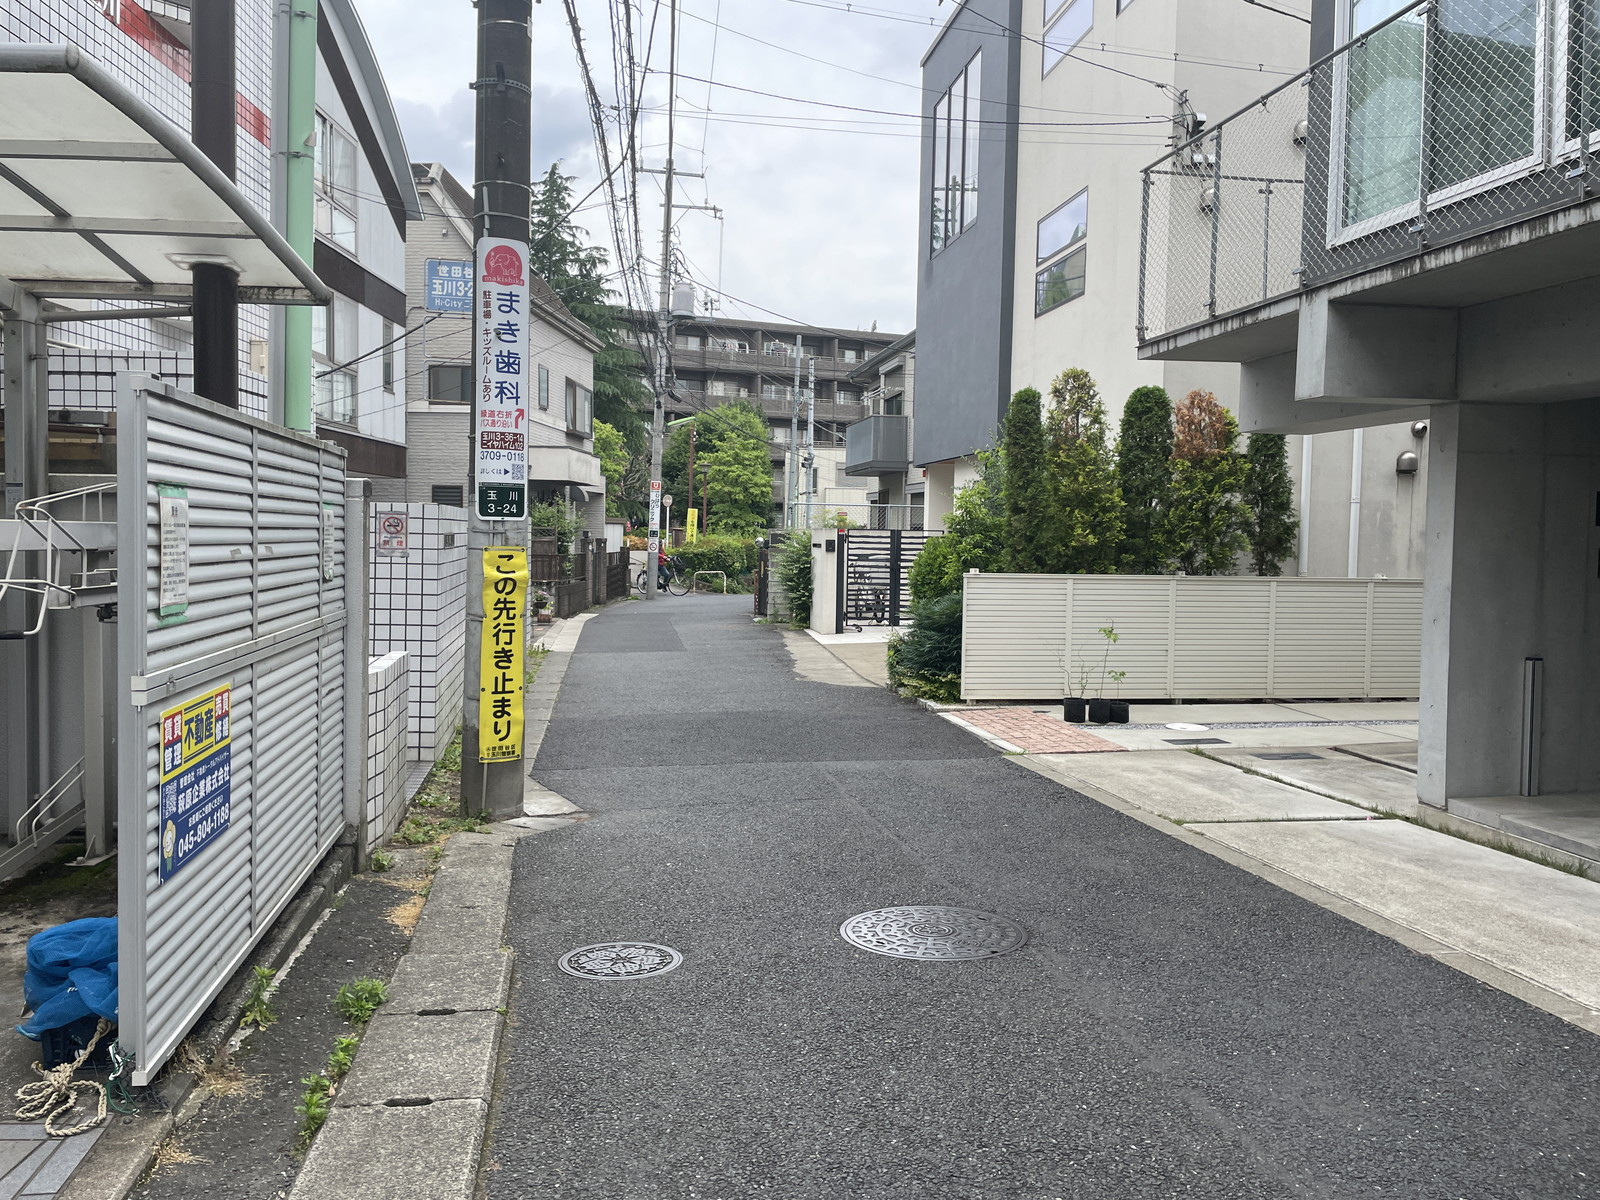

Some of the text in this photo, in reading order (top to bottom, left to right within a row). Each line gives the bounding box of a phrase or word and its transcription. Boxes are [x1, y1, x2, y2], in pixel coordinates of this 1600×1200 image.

[484, 275, 524, 285] makishika
[435, 298, 462, 308] Hi-City
[494, 291, 521, 405] まき歯科
[482, 432, 523, 442] 玉川3-36-14
[480, 450, 525, 462] 3709-0118
[487, 490, 518, 501] 玉川
[487, 503, 517, 514] 3-24
[492, 554, 518, 741] この先行き止まり
[164, 692, 229, 751] 賃貸 不動産 売買
[164, 742, 182, 772] 管理
[178, 802, 230, 858] 045-804-1188
